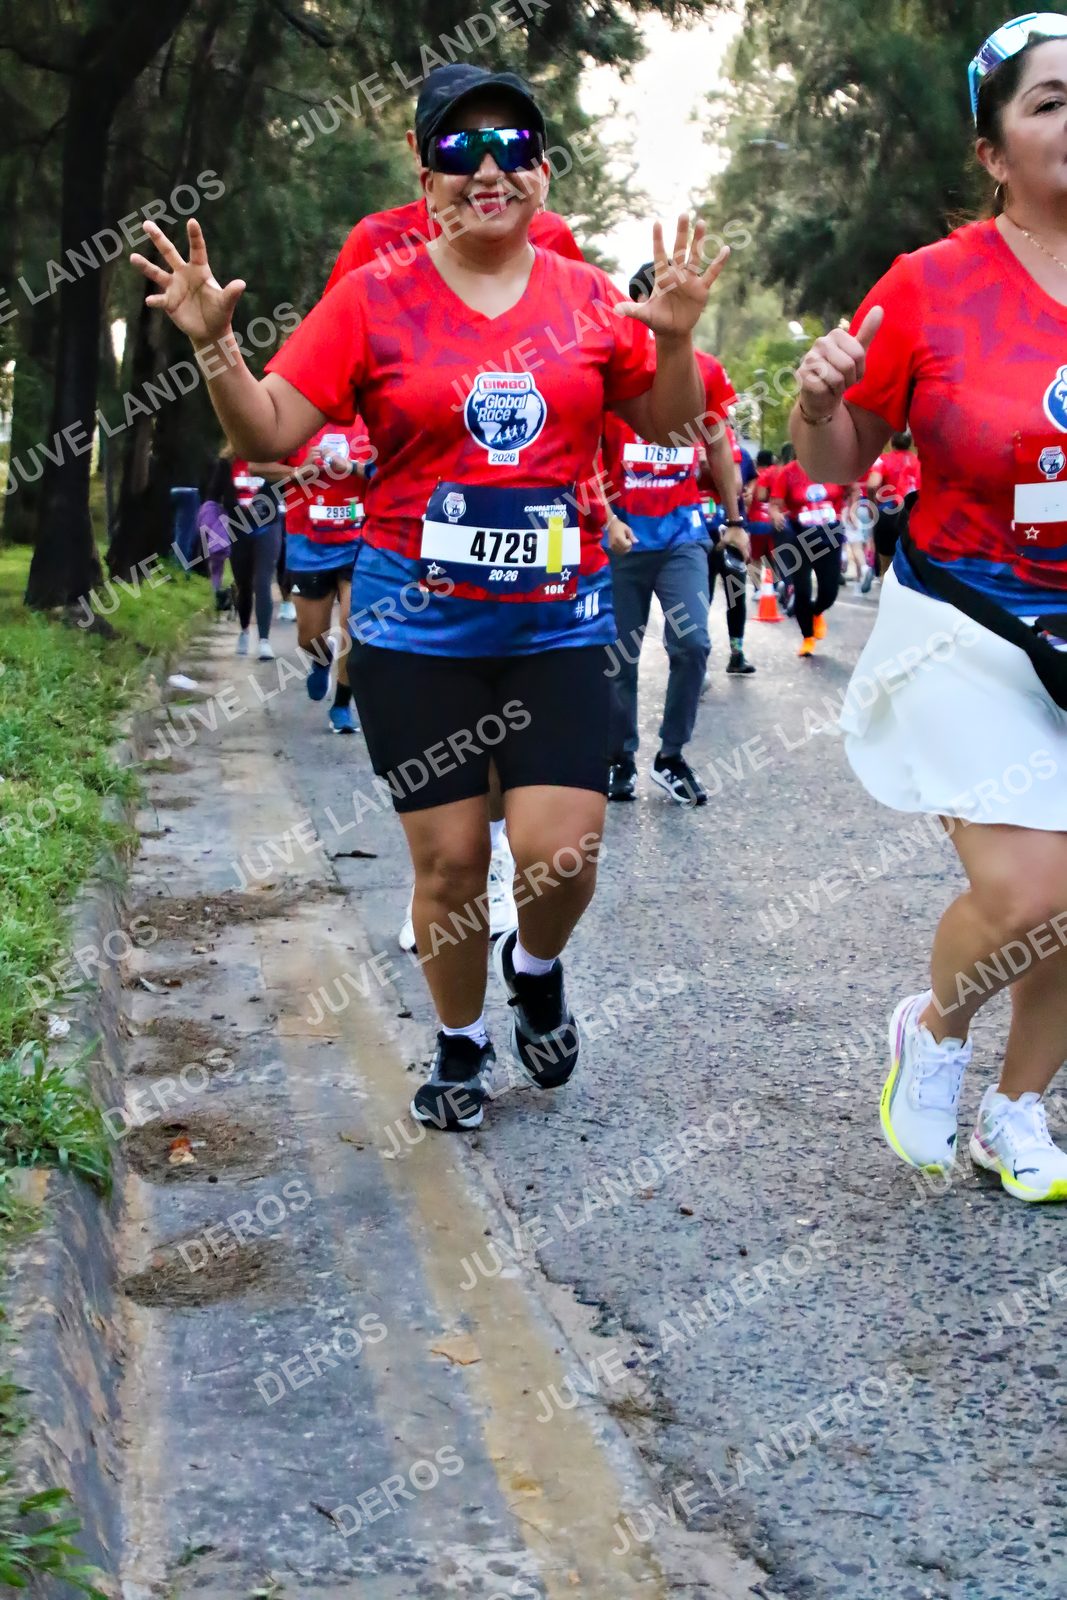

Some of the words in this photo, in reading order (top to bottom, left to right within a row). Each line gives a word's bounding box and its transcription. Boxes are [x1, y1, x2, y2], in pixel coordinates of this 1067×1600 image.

[483, 380, 527, 390] BIMBO
[485, 394, 528, 409] Global
[477, 407, 512, 422] Race
[491, 452, 517, 463] 2026
[644, 446, 679, 462] 17637
[326, 507, 352, 518] 2935
[470, 531, 538, 564] 4729
[544, 584, 565, 595] 10K
